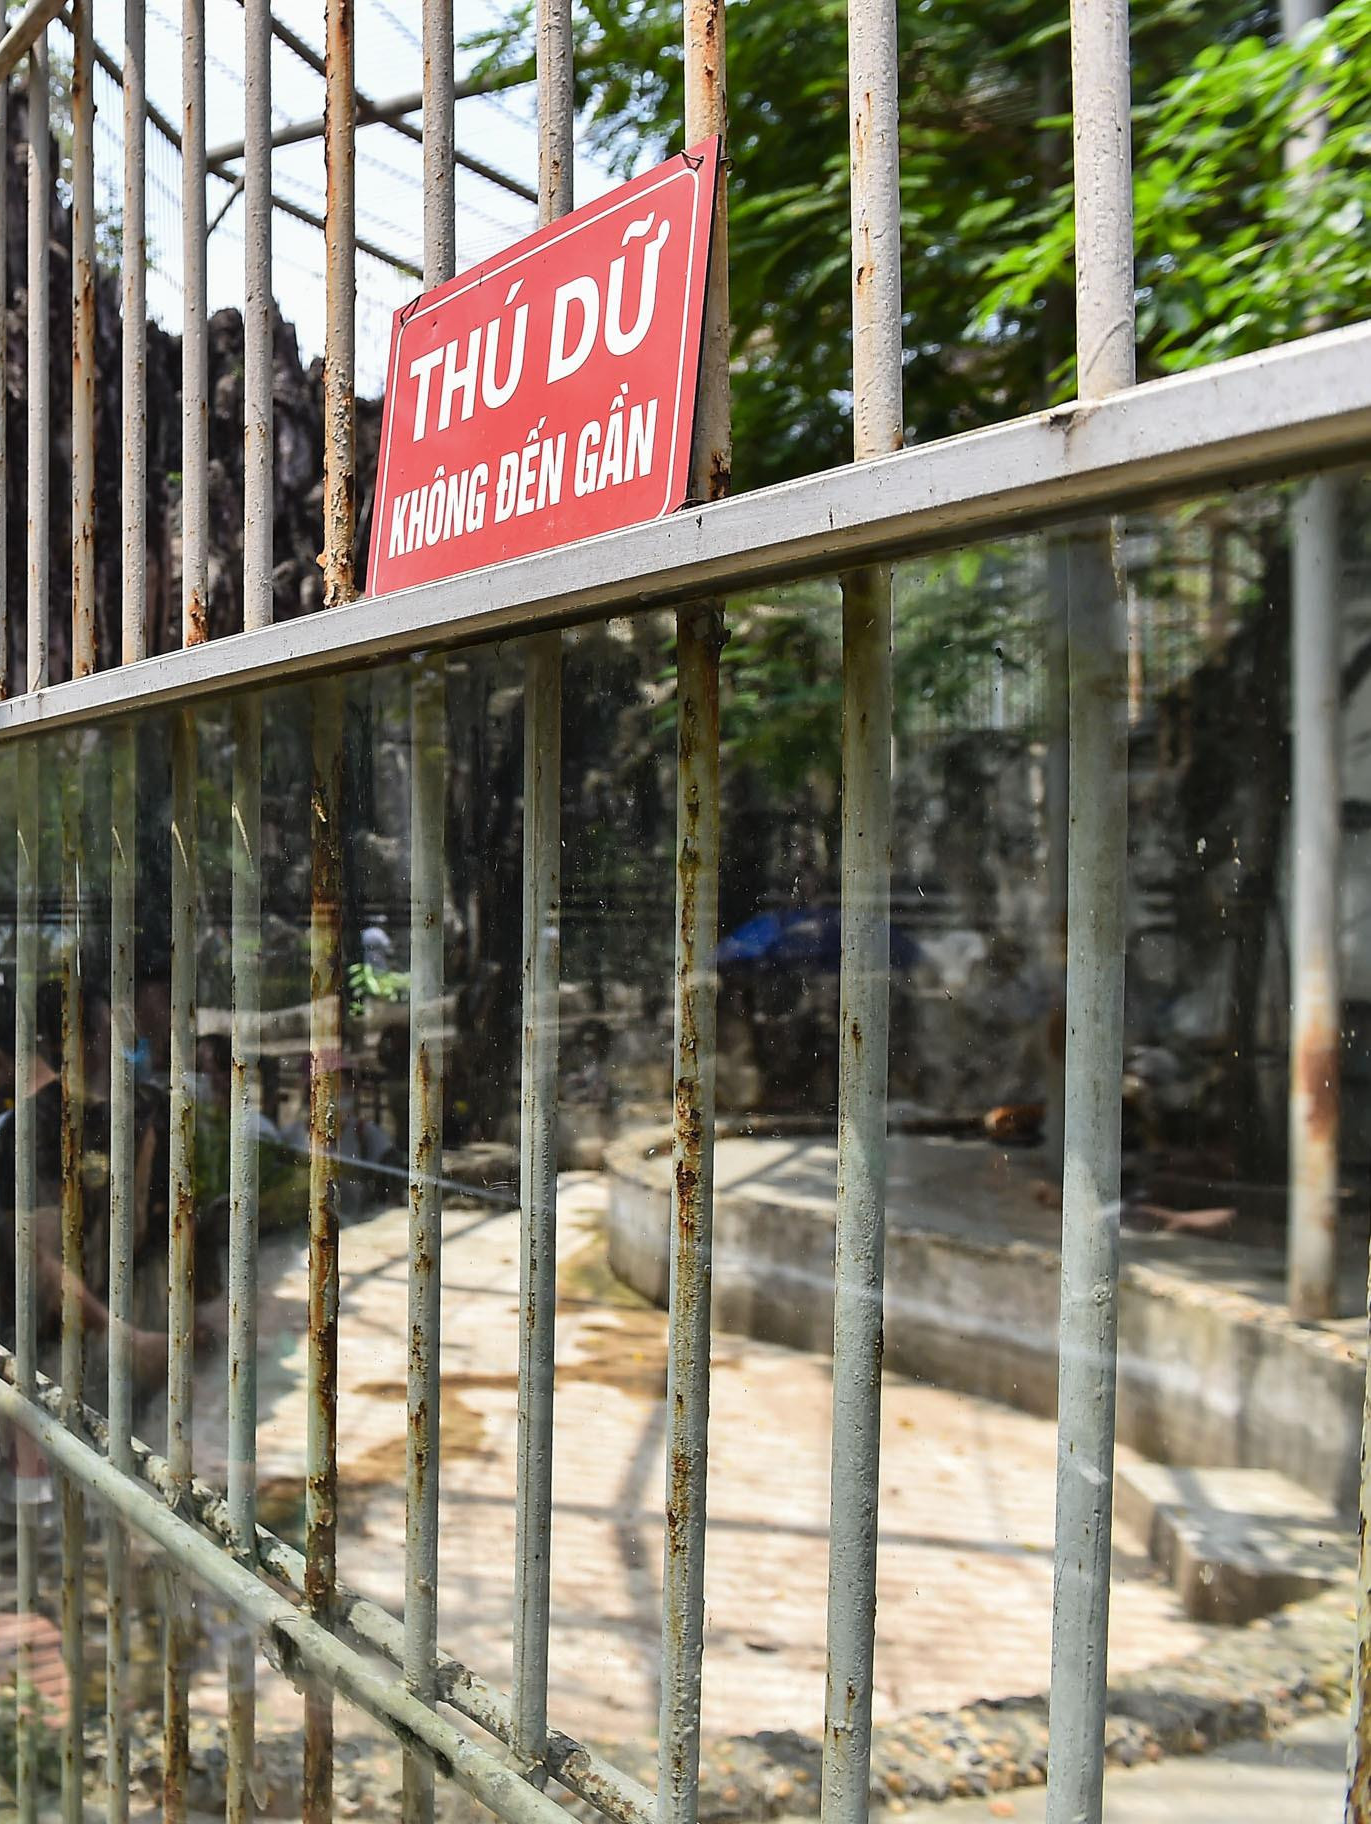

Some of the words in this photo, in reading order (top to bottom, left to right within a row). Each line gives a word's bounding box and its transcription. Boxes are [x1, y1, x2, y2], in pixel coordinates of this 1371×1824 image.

[410, 278, 529, 444] THÚ
[547, 211, 670, 385] DỮ
[388, 463, 488, 559] KHÔNG
[494, 415, 567, 524] ĐẾN
[574, 382, 658, 498] GẦN
